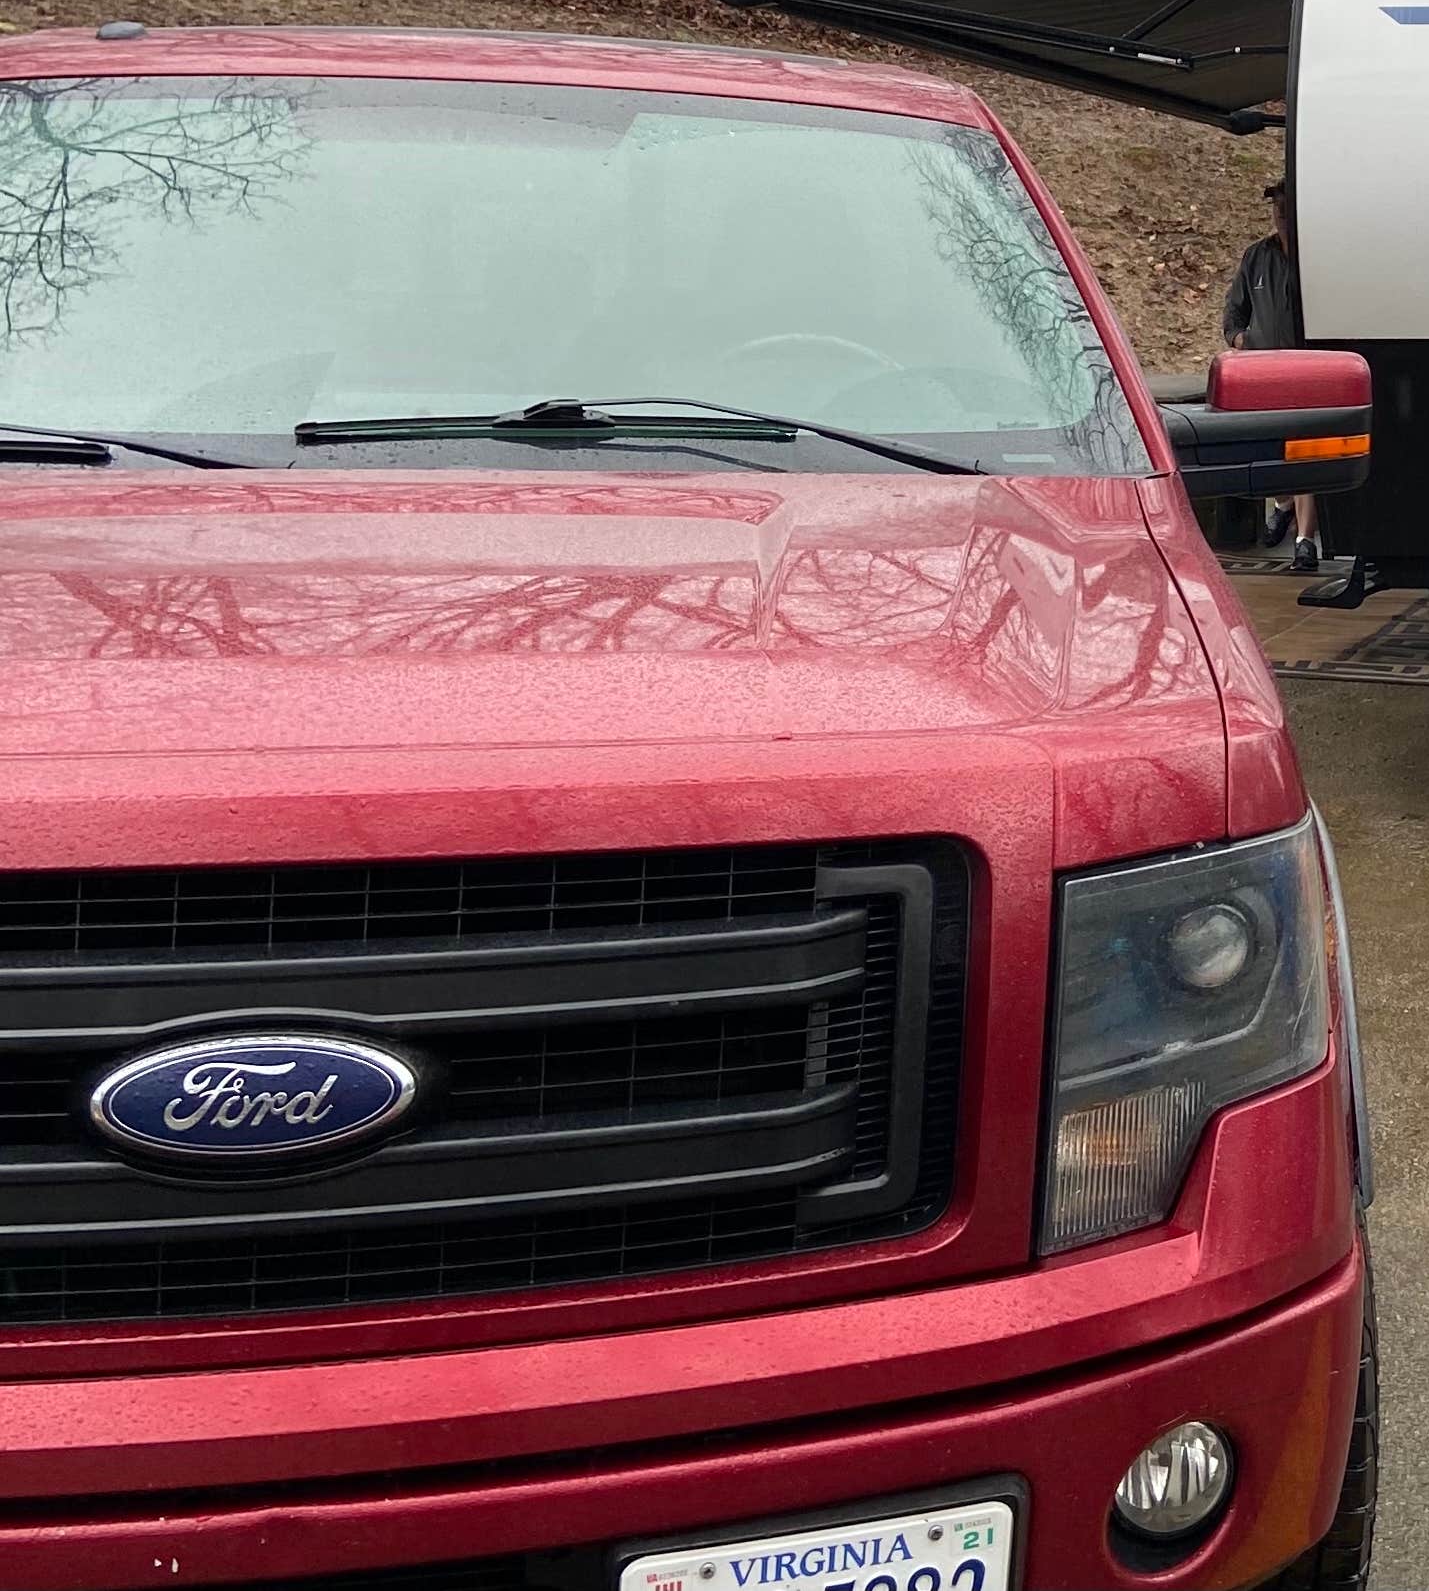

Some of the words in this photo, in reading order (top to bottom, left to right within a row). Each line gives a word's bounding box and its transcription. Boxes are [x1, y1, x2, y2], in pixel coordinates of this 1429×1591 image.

[163, 1061, 339, 1131] Ford
[729, 1533, 914, 1587] VIRGINIA
[963, 1527, 994, 1550] 21
